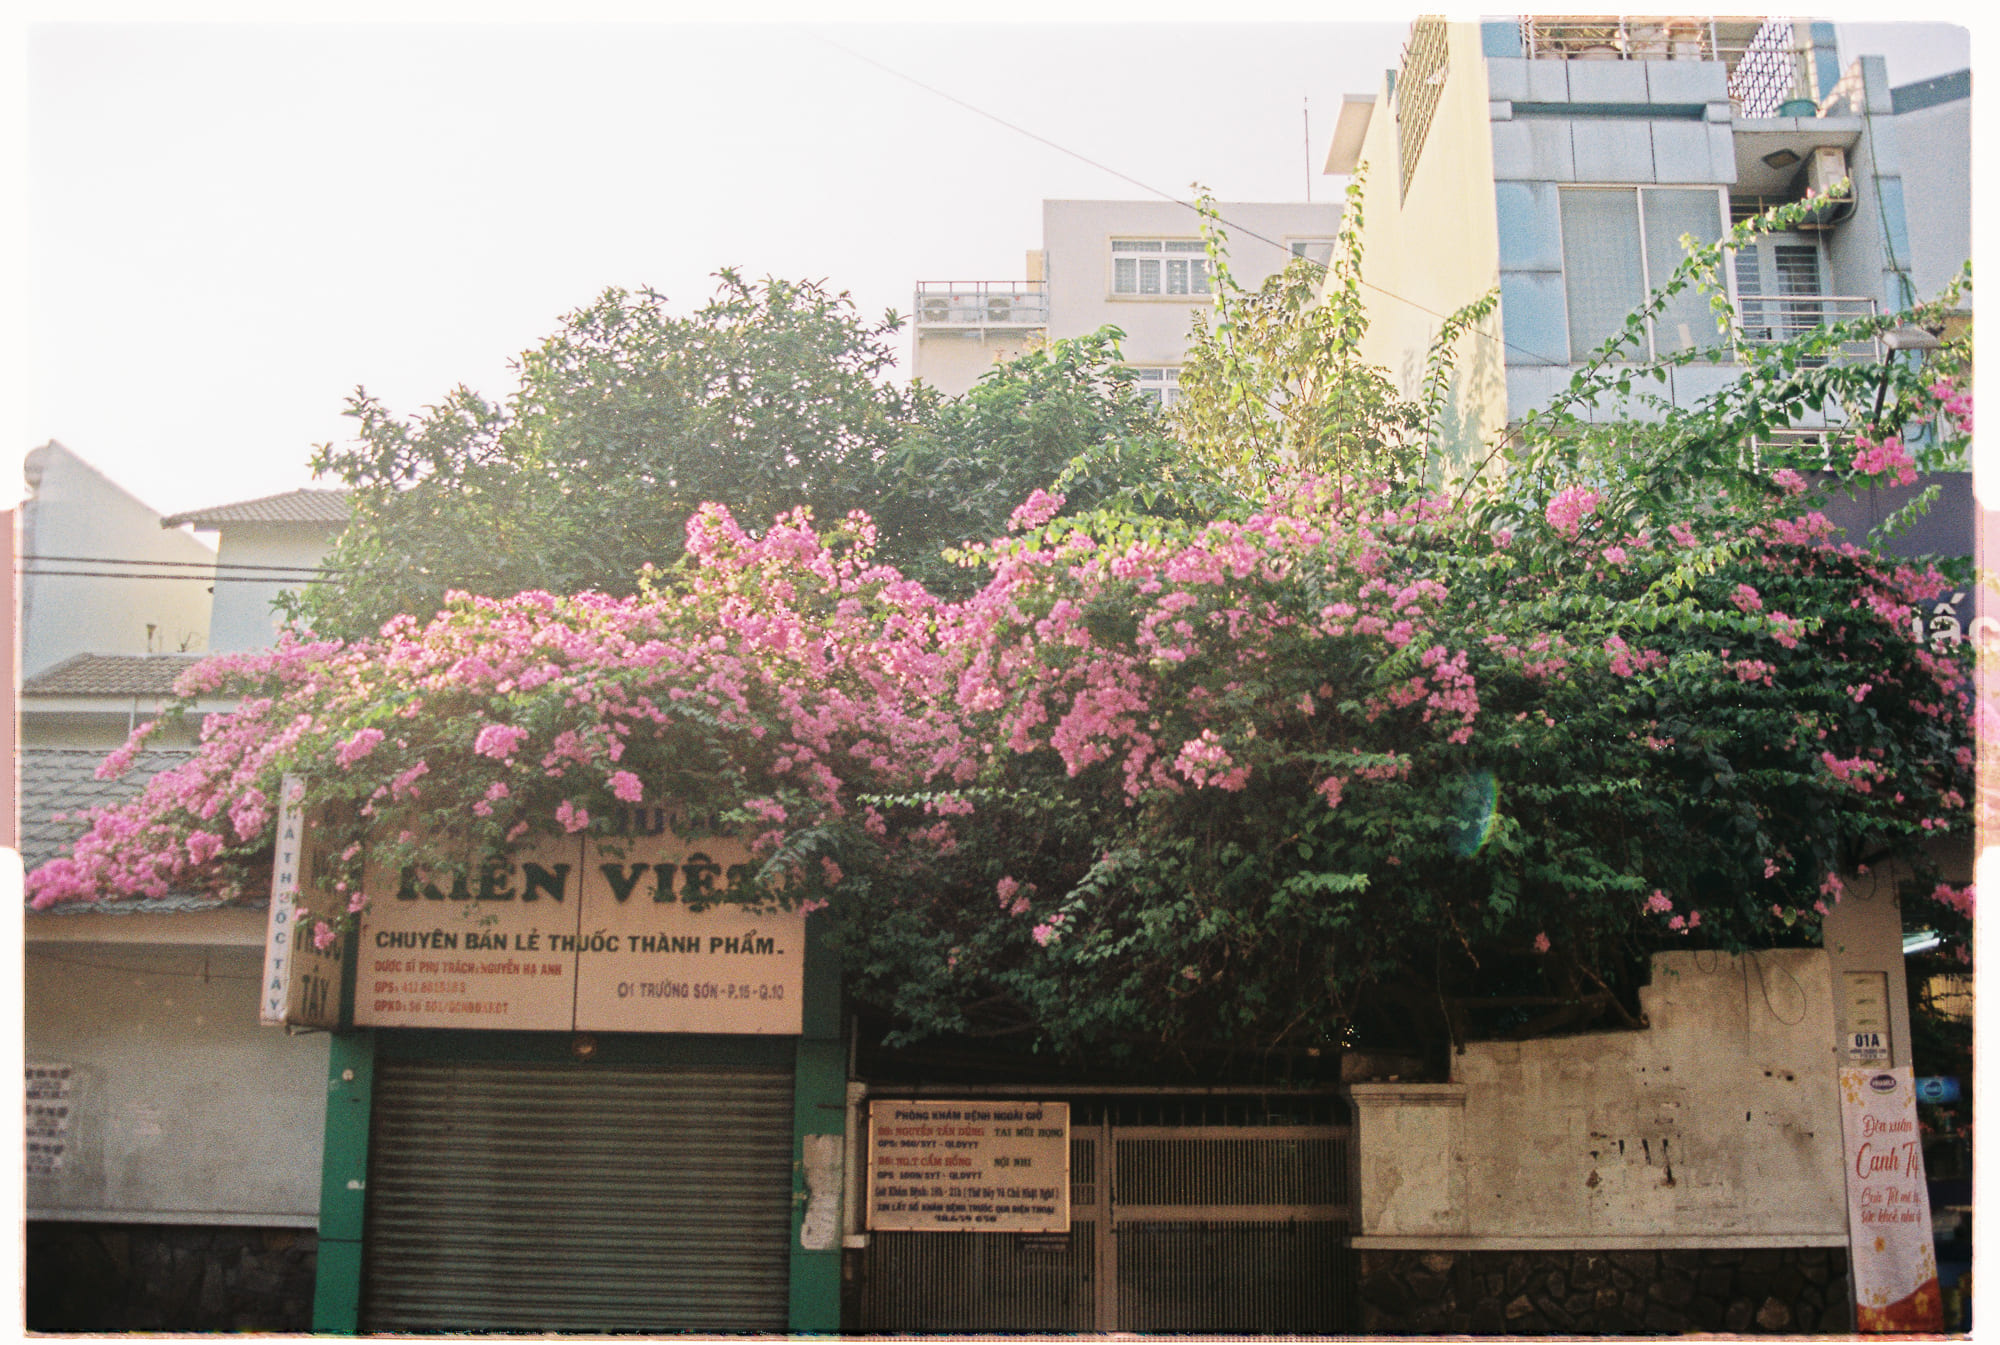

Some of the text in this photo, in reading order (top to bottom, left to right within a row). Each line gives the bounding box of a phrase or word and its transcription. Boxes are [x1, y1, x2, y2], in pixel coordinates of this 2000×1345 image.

[375, 928, 458, 950] CHUYÊN
[465, 929, 507, 951] BÁN
[515, 928, 541, 951] LẺ
[548, 928, 619, 953] THUỐC
[627, 932, 700, 954] THÀNH
[540, 963, 562, 976] ANH
[640, 979, 689, 999] TRƯỜNG
[693, 981, 718, 999] SƠN
[1855, 1033, 1880, 1047] 01A
[932, 1109, 961, 1120] KHÁM
[994, 1127, 1011, 1137] TAI
[1862, 1114, 1913, 1138] Đón xuân
[1856, 1142, 1898, 1179] Canh
